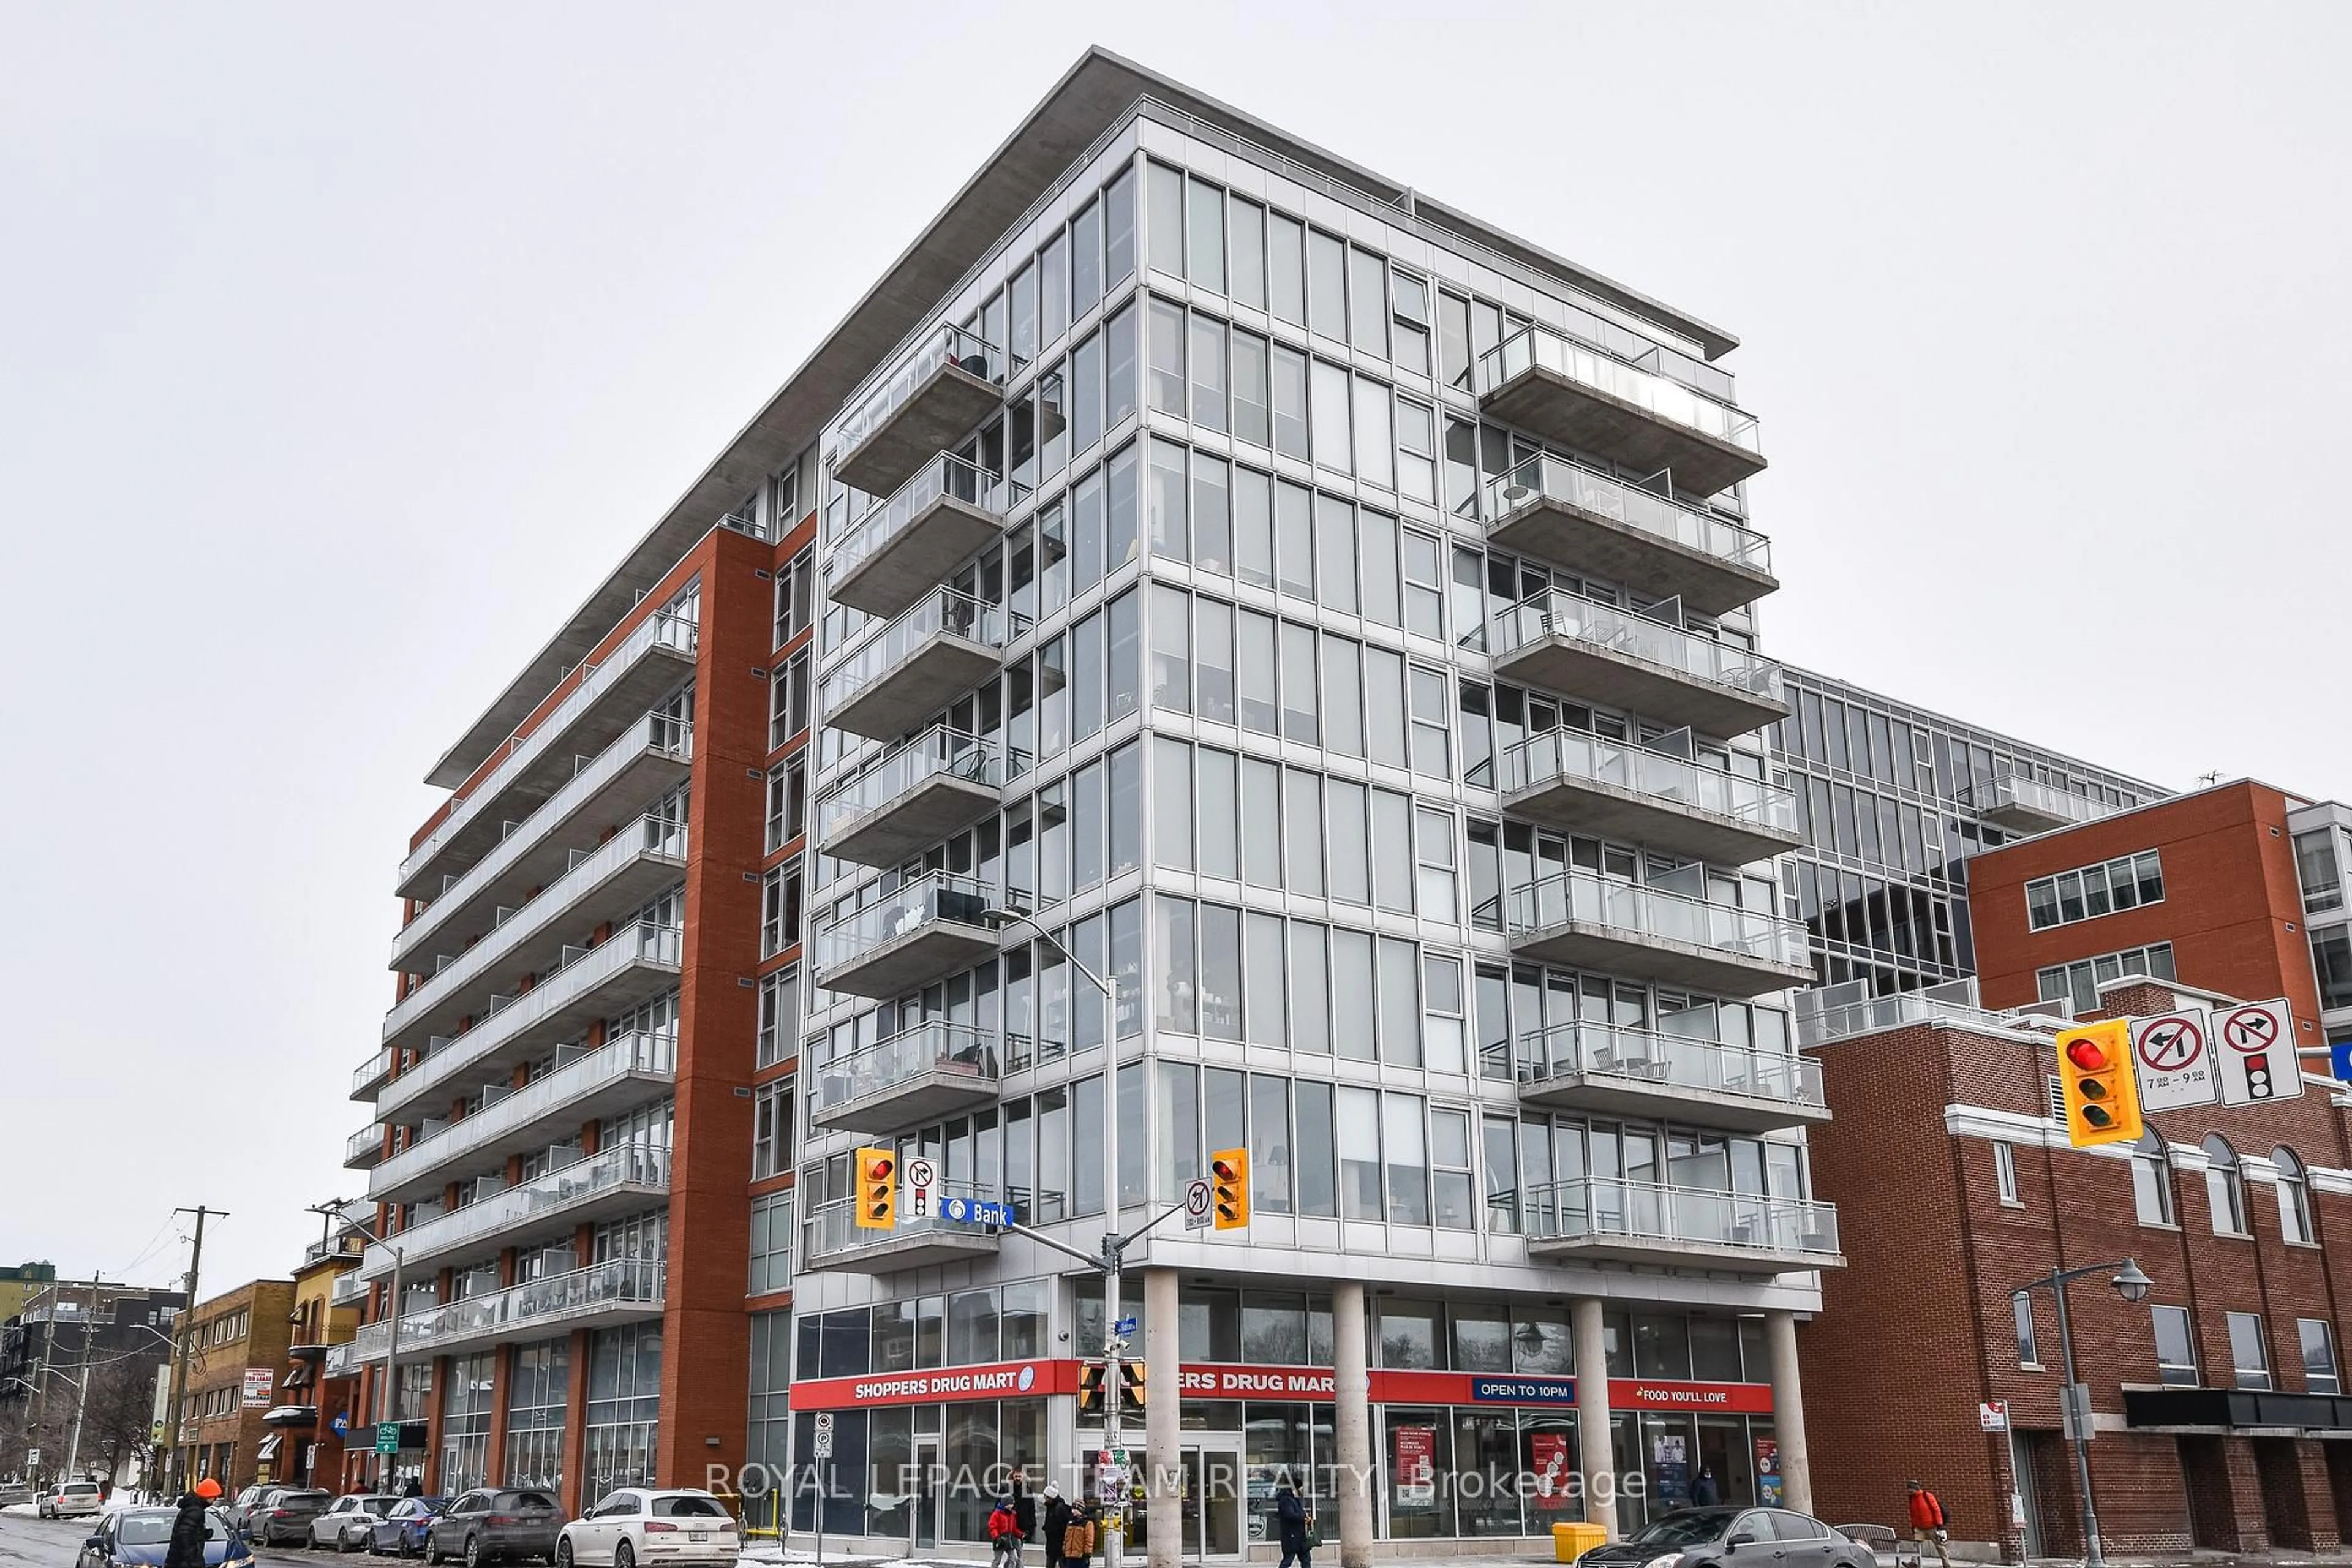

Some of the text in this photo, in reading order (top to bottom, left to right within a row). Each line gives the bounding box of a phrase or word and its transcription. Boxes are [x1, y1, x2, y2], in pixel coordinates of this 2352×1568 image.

[974, 1204, 1007, 1226] Bank
[855, 1371, 1017, 1399] SHOPPERS DRUG MART
[1222, 1373, 1284, 1391] DRUG
[1288, 1376, 1335, 1392] MAR
[1480, 1384, 1568, 1398] OPEN TO 10PM
[1643, 1390, 1727, 1403] FOOD YOU'LL LOVE
